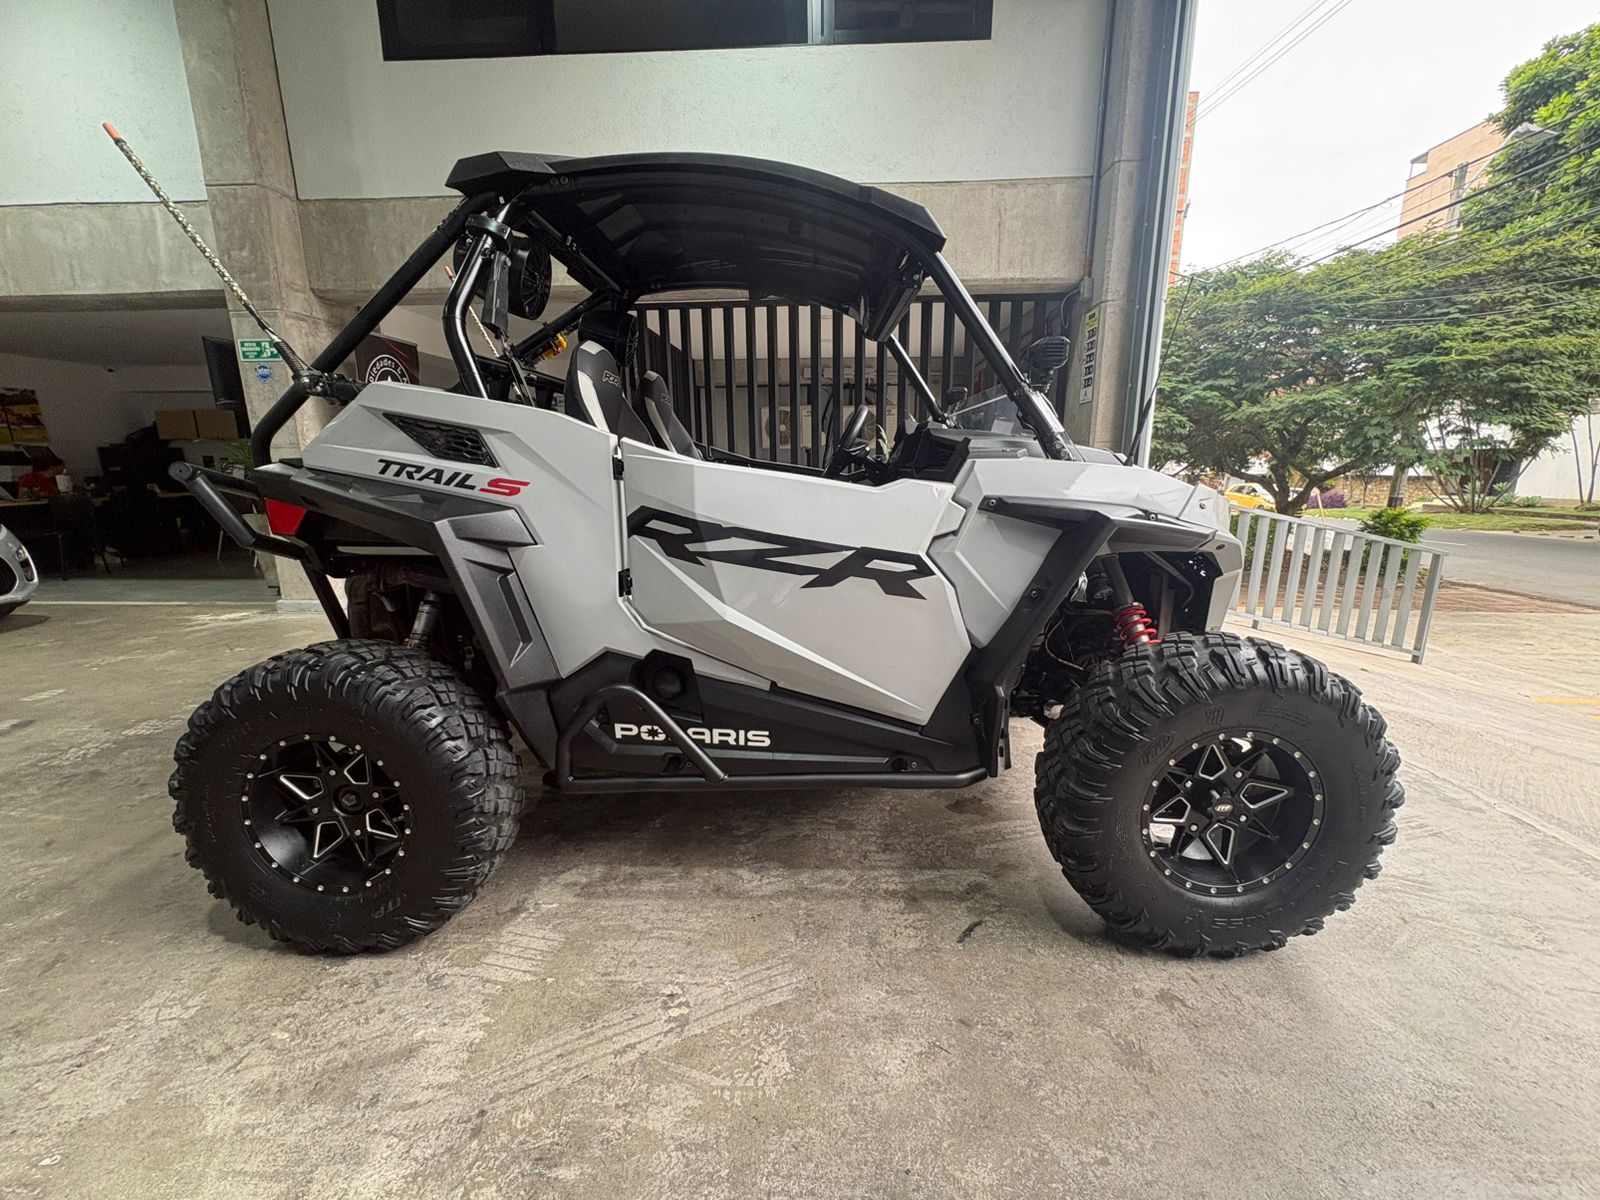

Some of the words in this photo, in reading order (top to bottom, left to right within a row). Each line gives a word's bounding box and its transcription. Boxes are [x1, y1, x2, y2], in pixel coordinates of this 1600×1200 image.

[377, 458, 477, 491] TRAIL
[479, 477, 531, 497] S
[627, 505, 936, 600] RZR
[614, 723, 771, 747] POARIS
